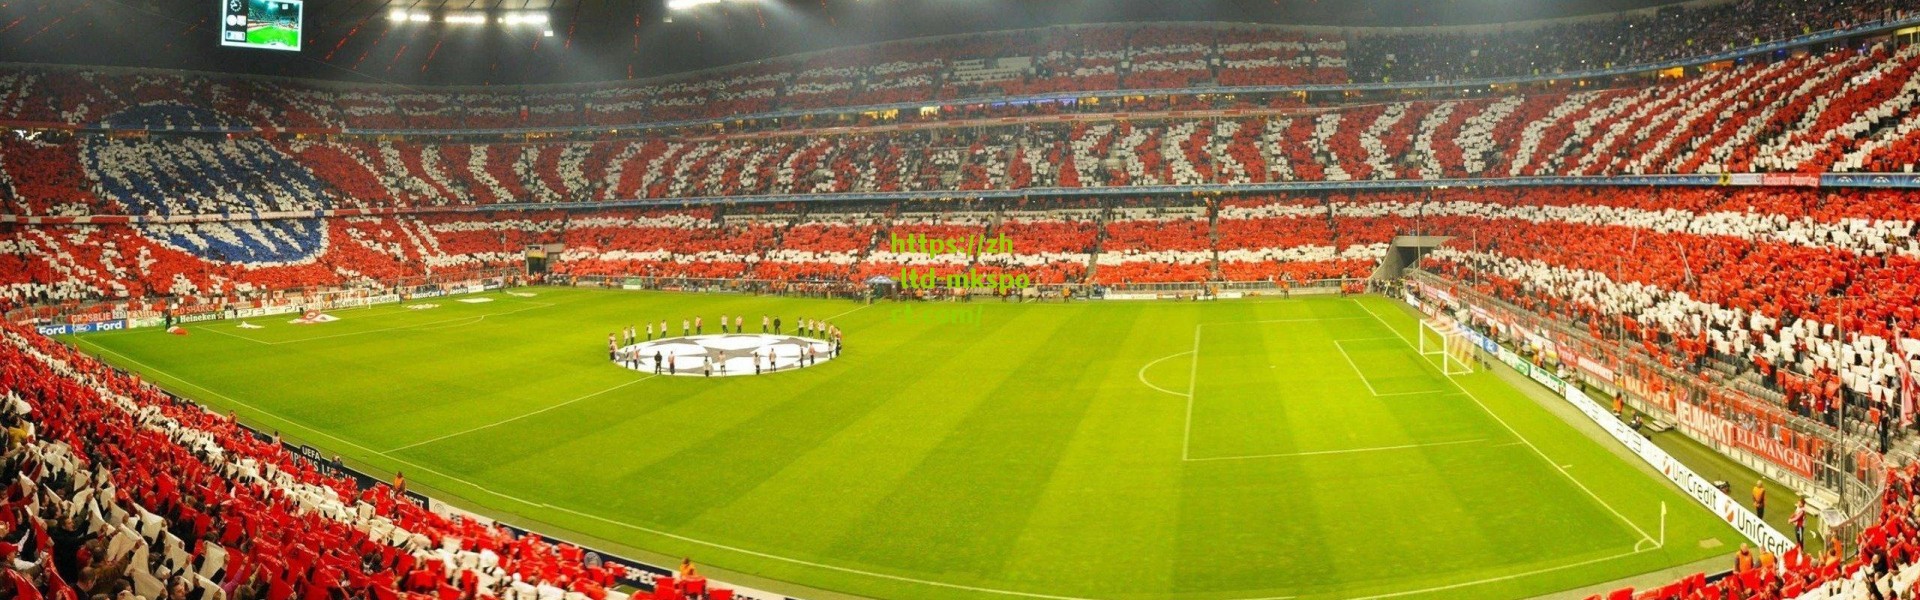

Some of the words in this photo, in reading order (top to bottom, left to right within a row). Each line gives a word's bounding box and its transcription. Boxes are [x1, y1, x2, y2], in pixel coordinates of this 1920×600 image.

[39, 326, 66, 335] Ford
[96, 321, 123, 331] Ford
[180, 313, 217, 323] Heineken
[1676, 400, 1734, 445] NEUMARKT
[301, 446, 320, 460] UEFA
[1736, 430, 1812, 476] ELLWANGEN
[1672, 463, 1717, 510] UniCredit
